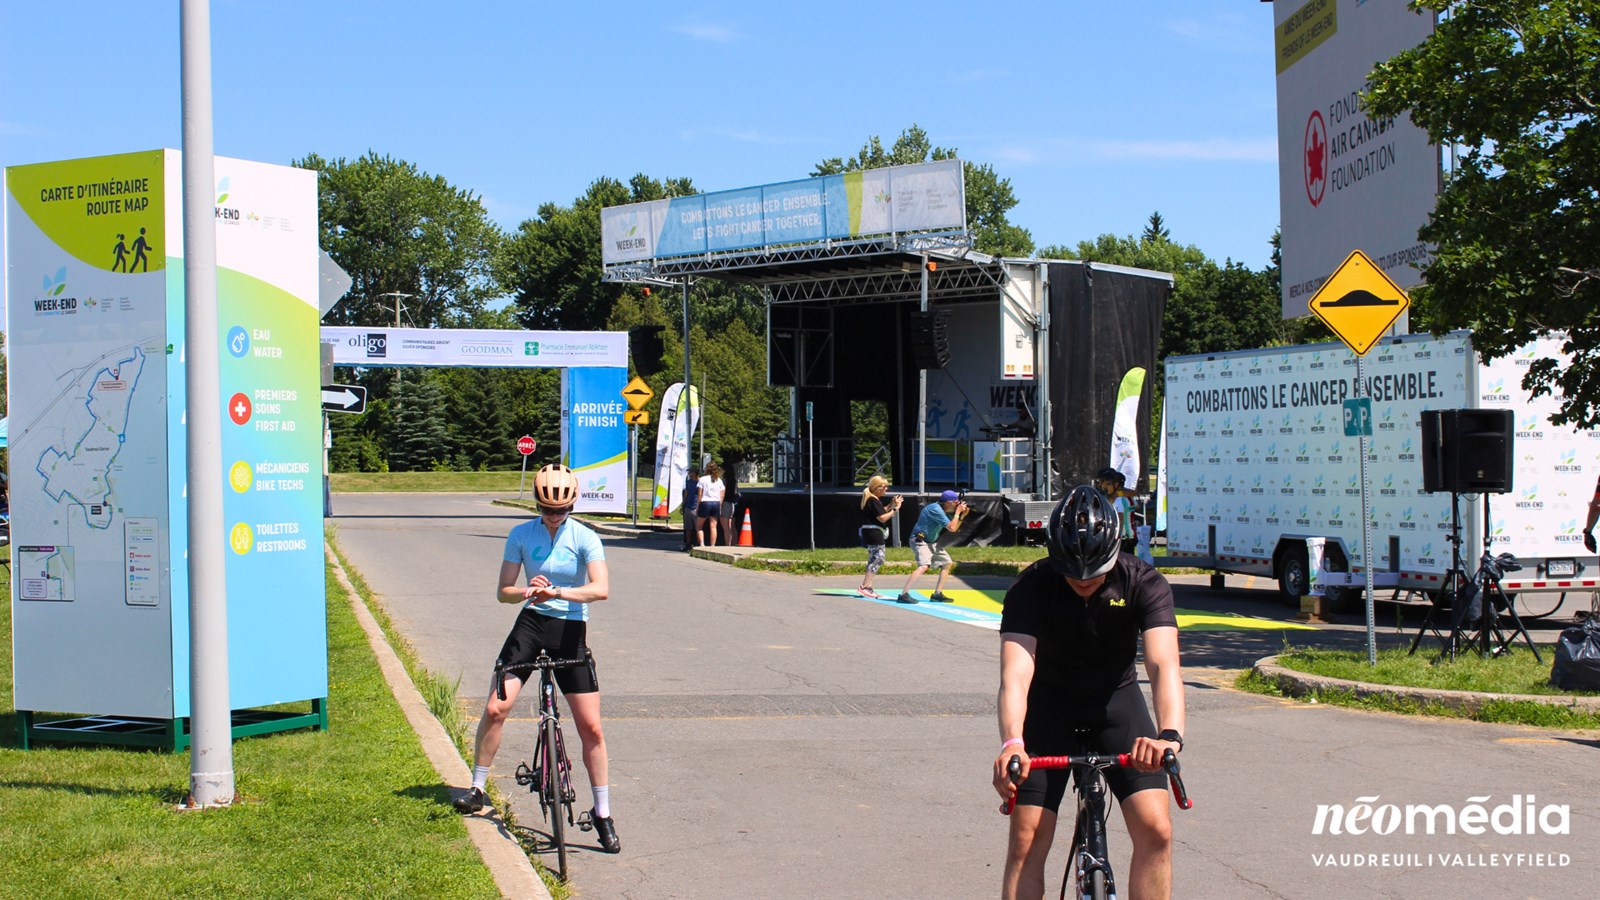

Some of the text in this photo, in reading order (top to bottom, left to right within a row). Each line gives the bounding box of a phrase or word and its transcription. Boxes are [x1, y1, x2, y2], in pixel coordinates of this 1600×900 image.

[1331, 113, 1394, 160] AIR CANADA
[1332, 142, 1395, 192] FOUNDATION
[40, 178, 148, 203] CARTE D'ITINÉRAIRE
[86, 197, 148, 216] ROUTE MAP
[681, 207, 733, 224] COMBATTONS
[736, 206, 744, 217] LE
[747, 201, 780, 216] CANCER
[214, 208, 240, 220] K-END
[716, 223, 738, 237] FIGHT
[741, 220, 772, 234] CANCER
[616, 238, 646, 250] WEEK-END
[1387, 254, 1398, 269] OUR
[1398, 244, 1427, 266] SPONSORS
[34, 298, 76, 311] WEEK-END
[254, 329, 270, 341] EAU
[349, 335, 386, 352] oligo
[461, 346, 512, 354] GOODMAN
[254, 346, 282, 359] WATER
[255, 390, 297, 401] PREMIERS
[990, 386, 1037, 408] WEEK
[1187, 385, 1268, 414] COMBATTONS
[1272, 384, 1286, 408] LE
[1291, 379, 1348, 407] CANCER
[255, 403, 280, 415] SOINS
[573, 400, 623, 414] ARRIVÉE
[256, 420, 296, 432] FIRST AID
[578, 416, 618, 427] FINISH
[256, 460, 309, 474] MÉCANICIENS
[256, 479, 304, 491] BIKE TECHS
[256, 523, 299, 535] TOILETTES
[256, 541, 306, 552] RESTROOMS
